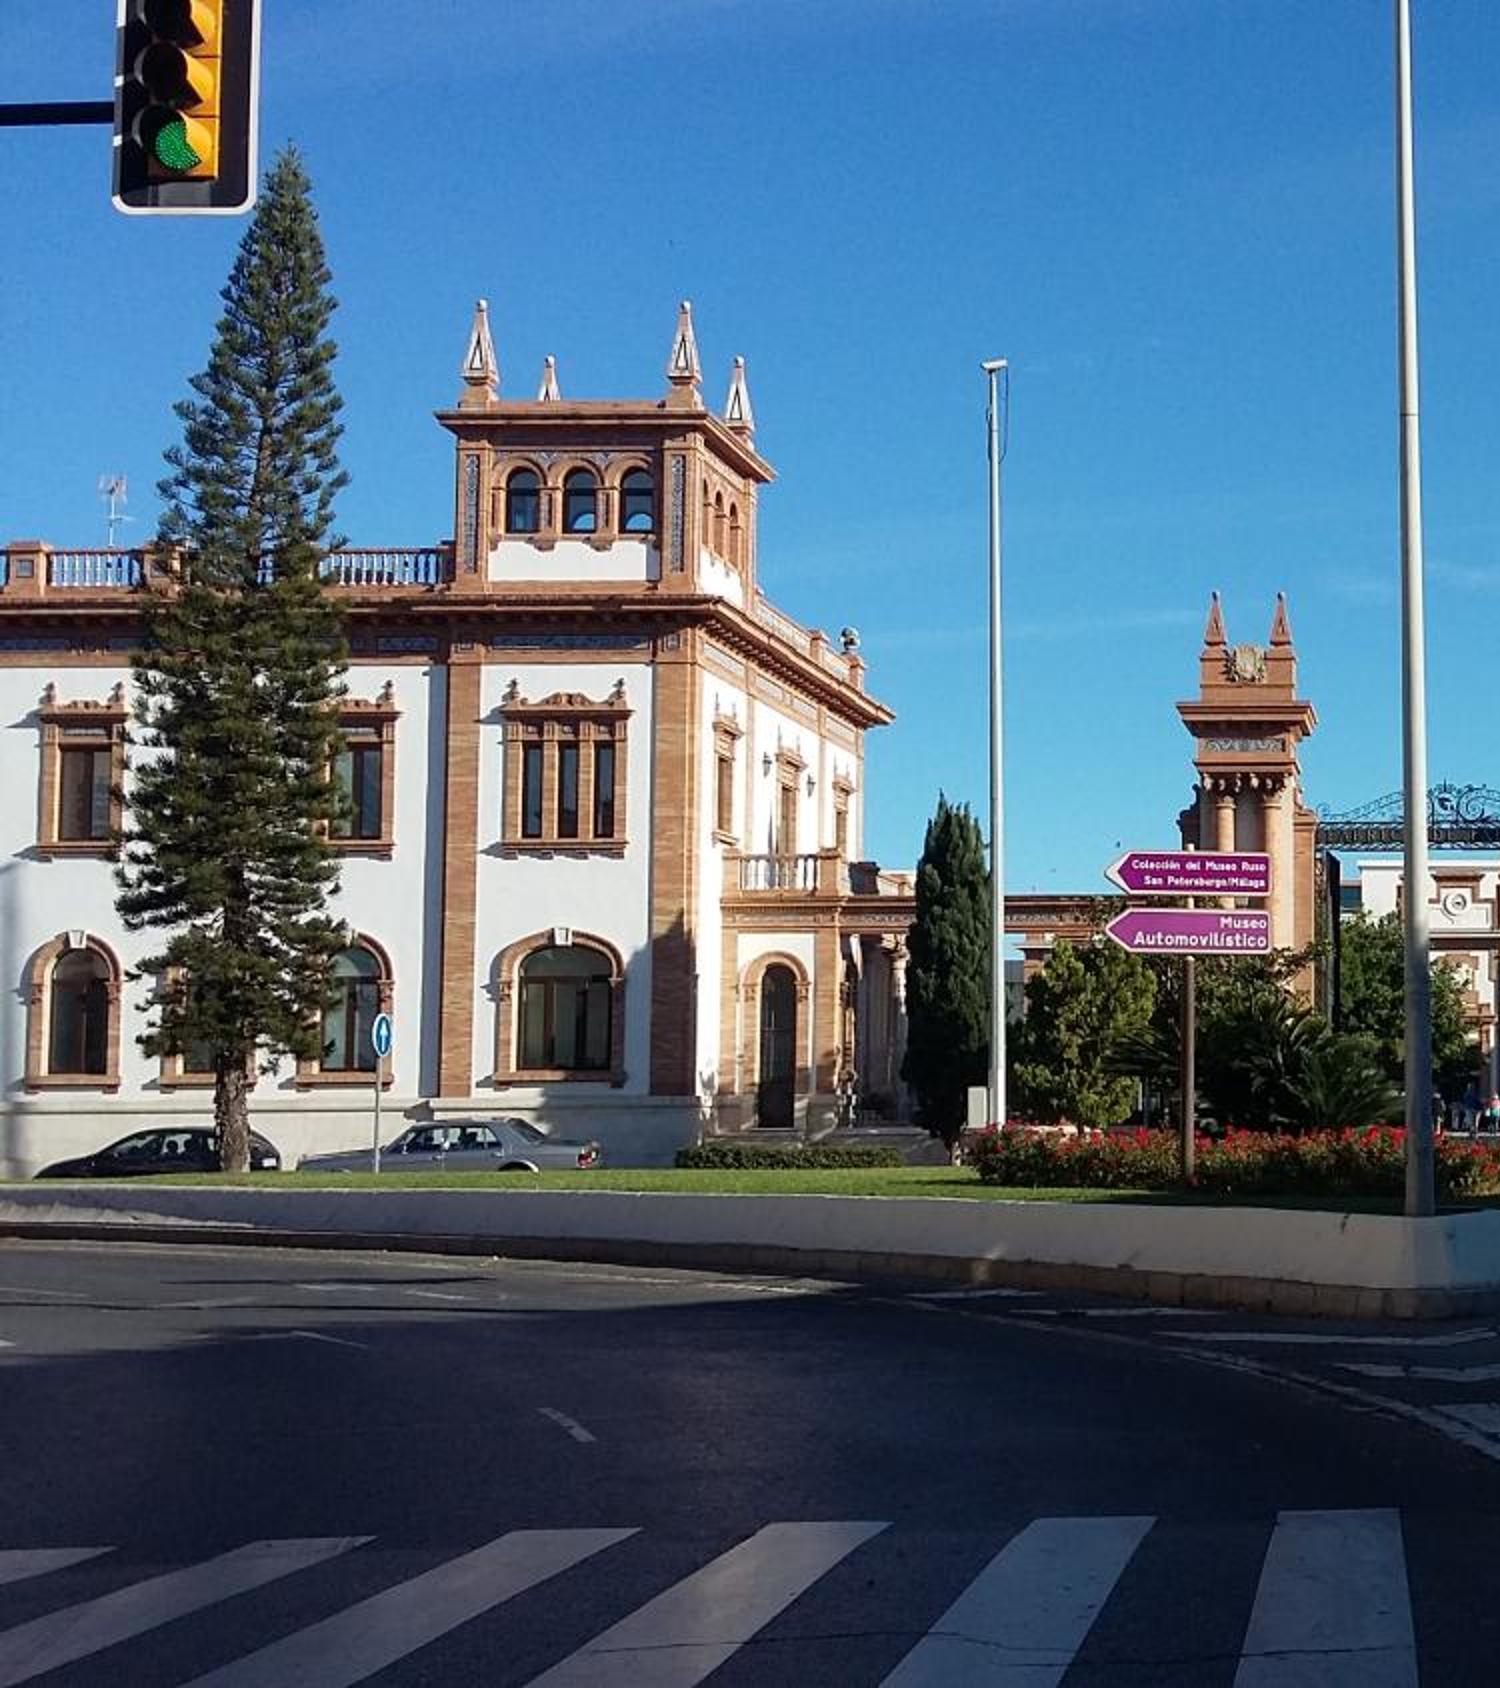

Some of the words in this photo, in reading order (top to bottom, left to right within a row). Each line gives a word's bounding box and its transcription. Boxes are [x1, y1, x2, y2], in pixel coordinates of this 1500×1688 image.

[1132, 860, 1180, 870] Colección
[1186, 861, 1200, 870] del
[1206, 861, 1237, 871] Museo
[1242, 862, 1267, 871] Ruso
[1144, 876, 1163, 885] San
[1220, 917, 1267, 929] Museo
[1134, 931, 1267, 947] Automovilístico
